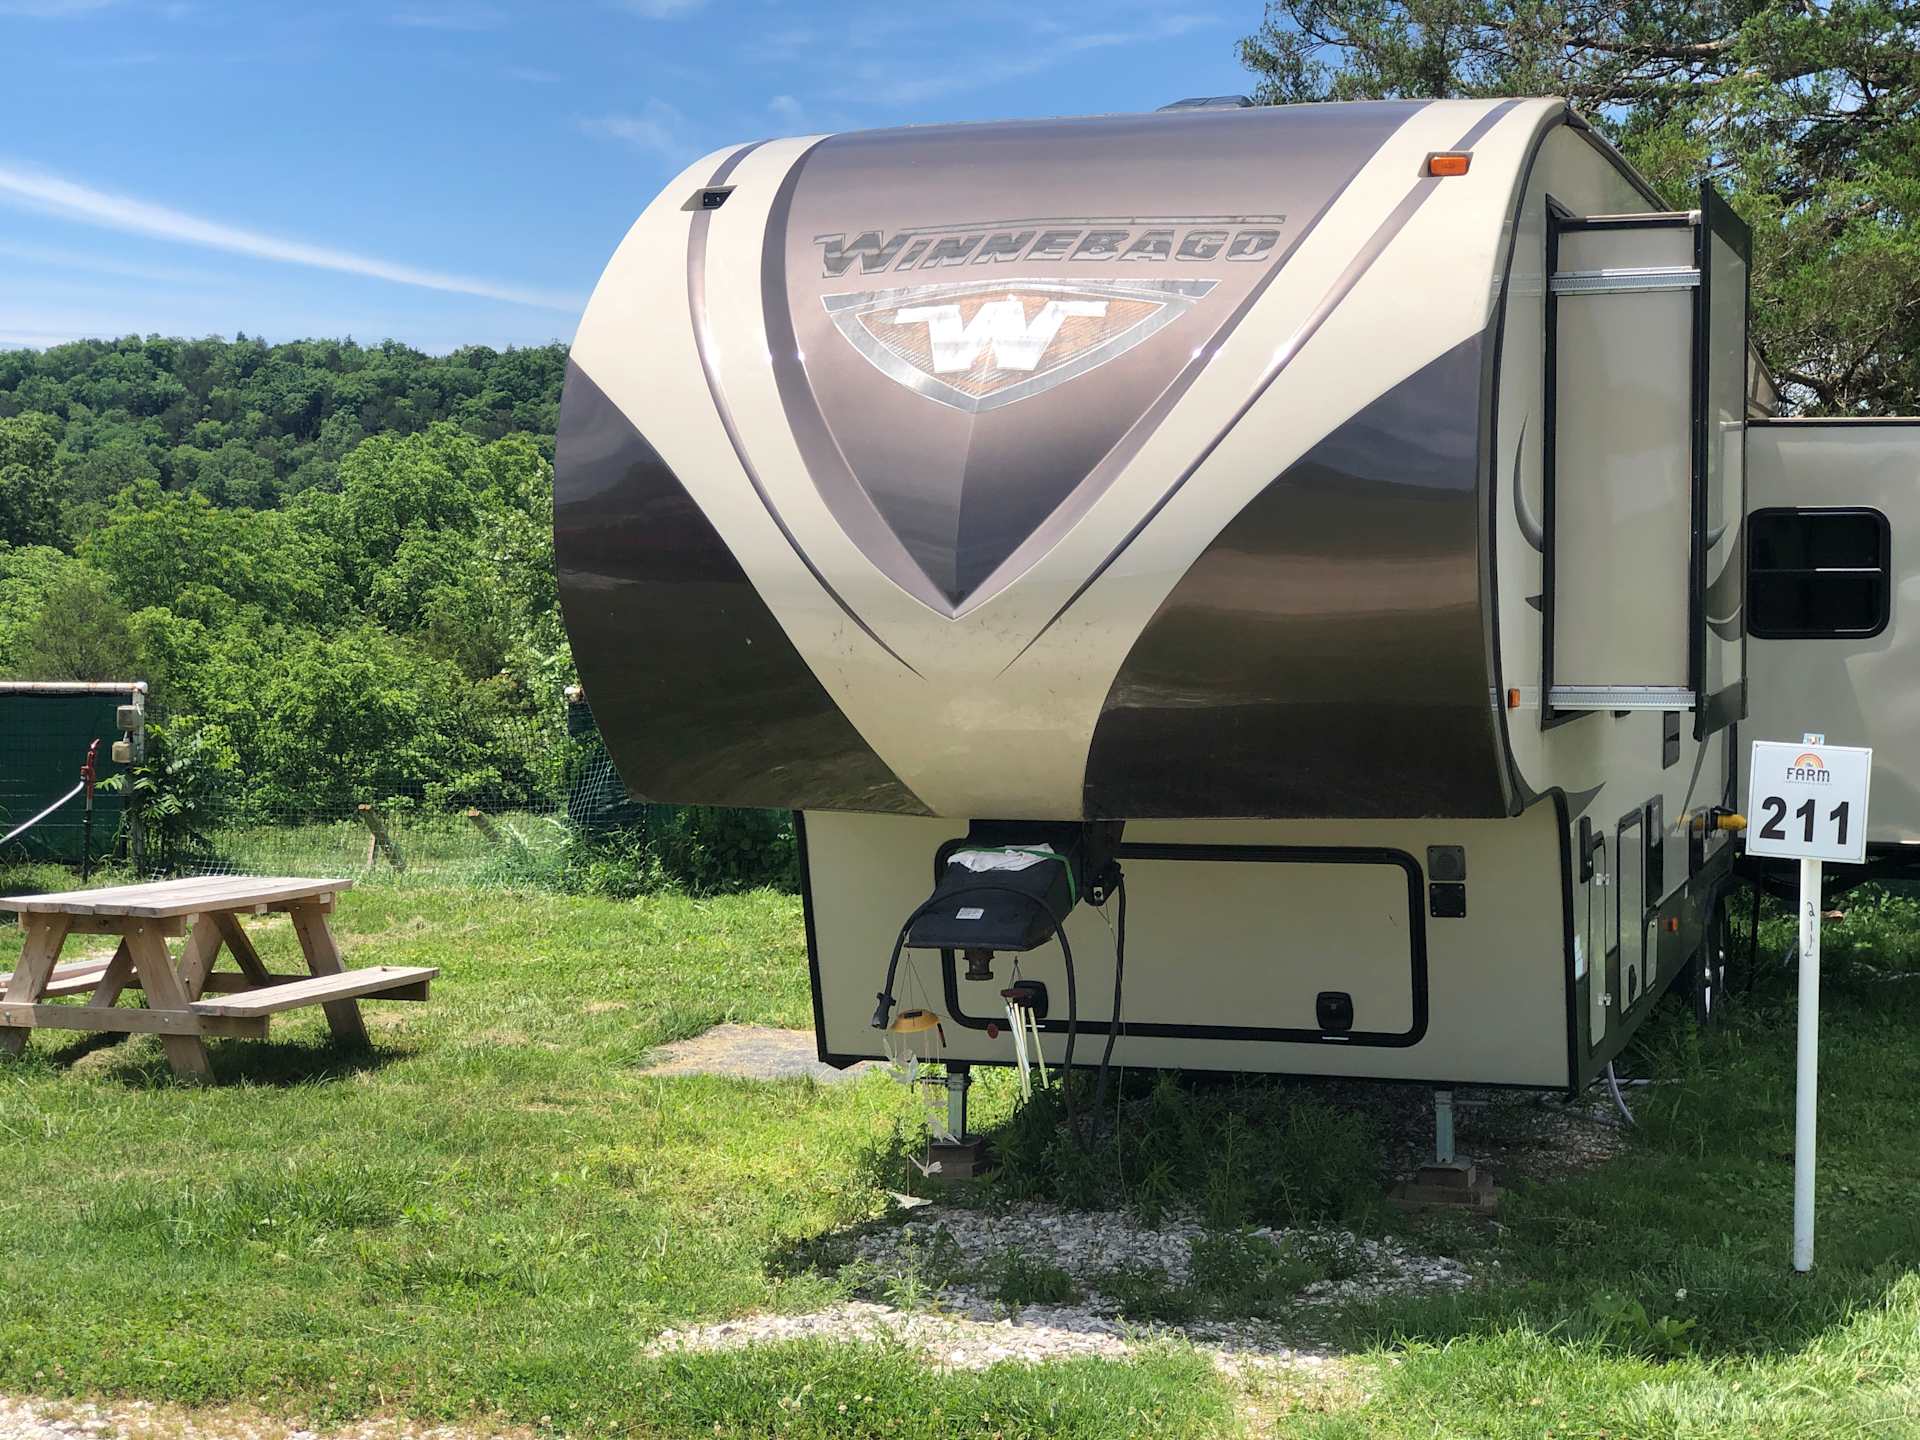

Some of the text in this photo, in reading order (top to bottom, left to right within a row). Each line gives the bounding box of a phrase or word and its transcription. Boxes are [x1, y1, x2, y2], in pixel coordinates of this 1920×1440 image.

[814, 229, 1282, 279] WINNEBAGO
[1786, 767, 1830, 783] FARM
[1759, 796, 1850, 845] 211
